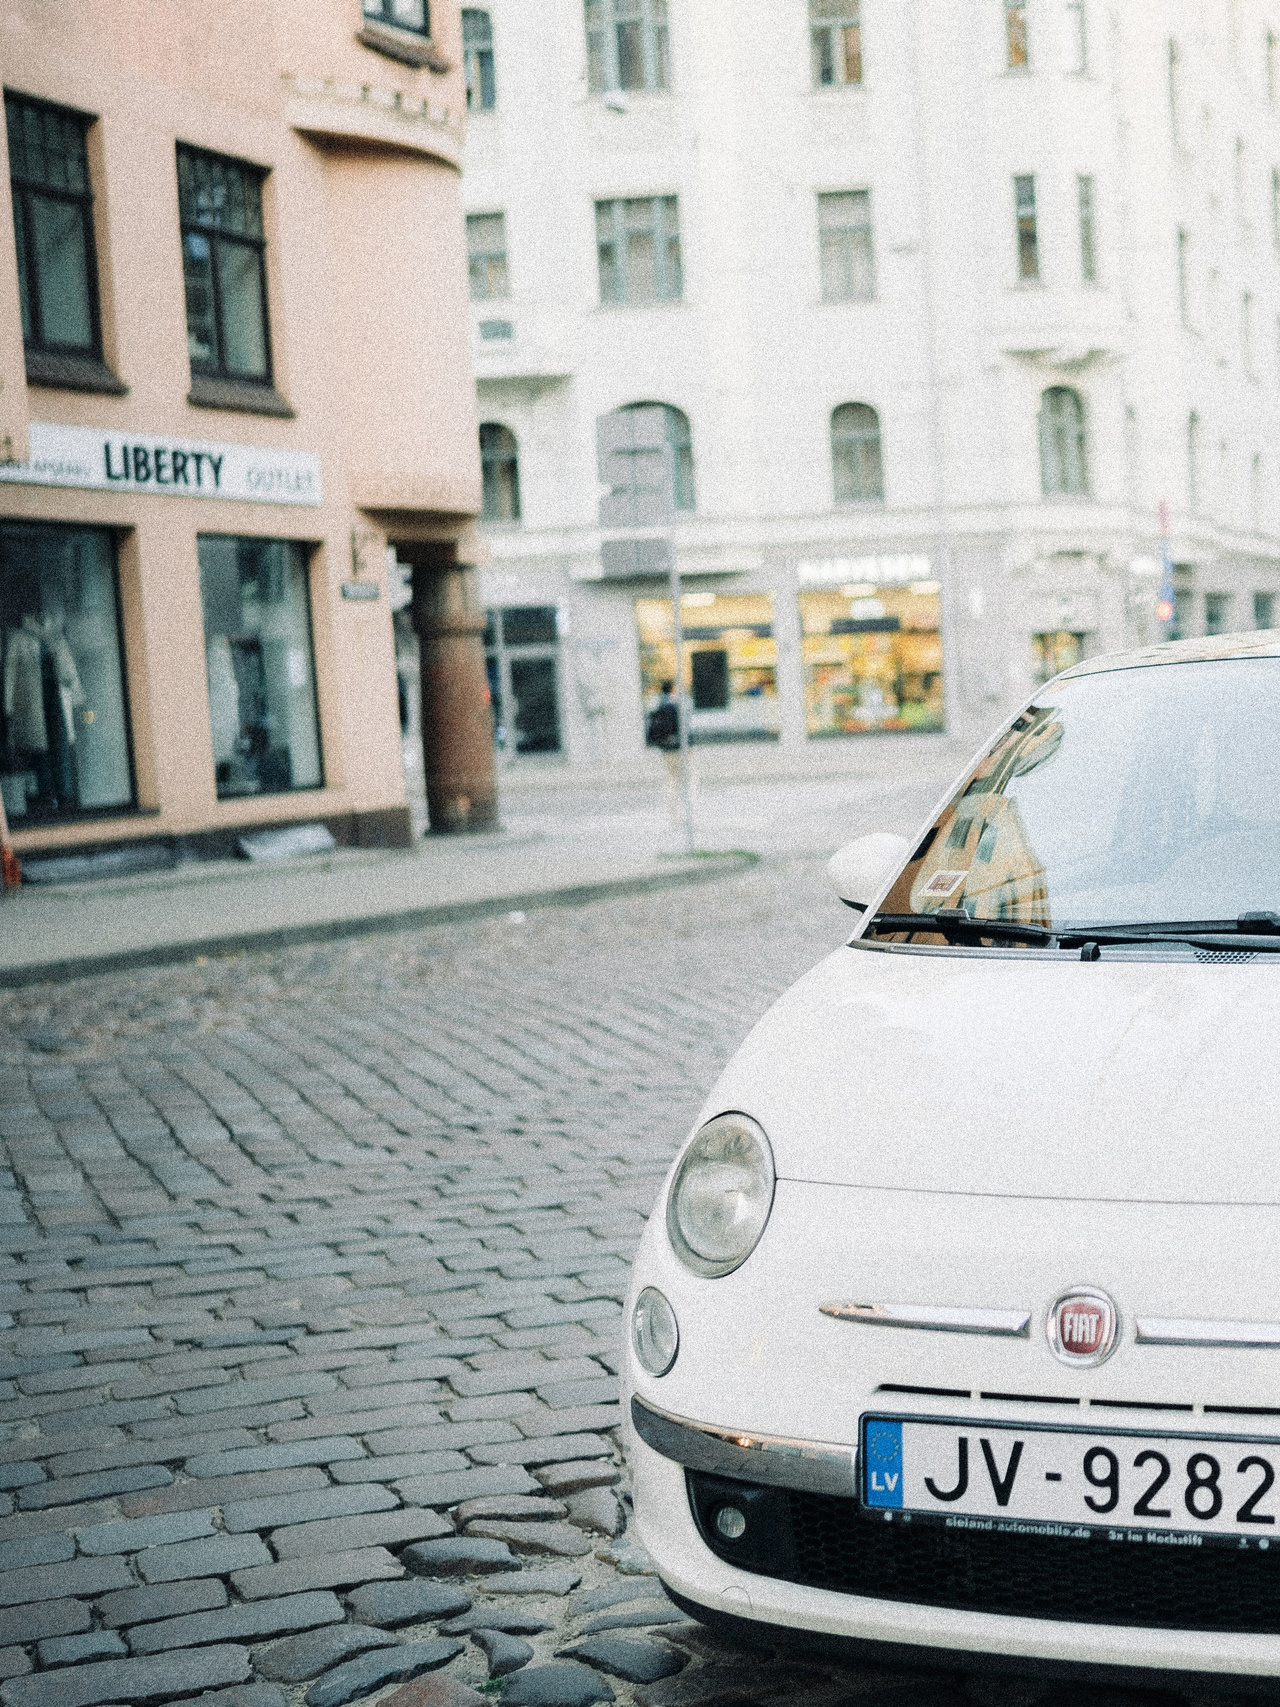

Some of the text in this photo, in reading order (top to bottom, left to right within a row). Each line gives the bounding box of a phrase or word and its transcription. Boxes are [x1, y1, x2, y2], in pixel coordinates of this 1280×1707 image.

[104, 442, 223, 489] LIBERTY
[1063, 1312, 1100, 1344] FIAT
[871, 1471, 899, 1492] LV
